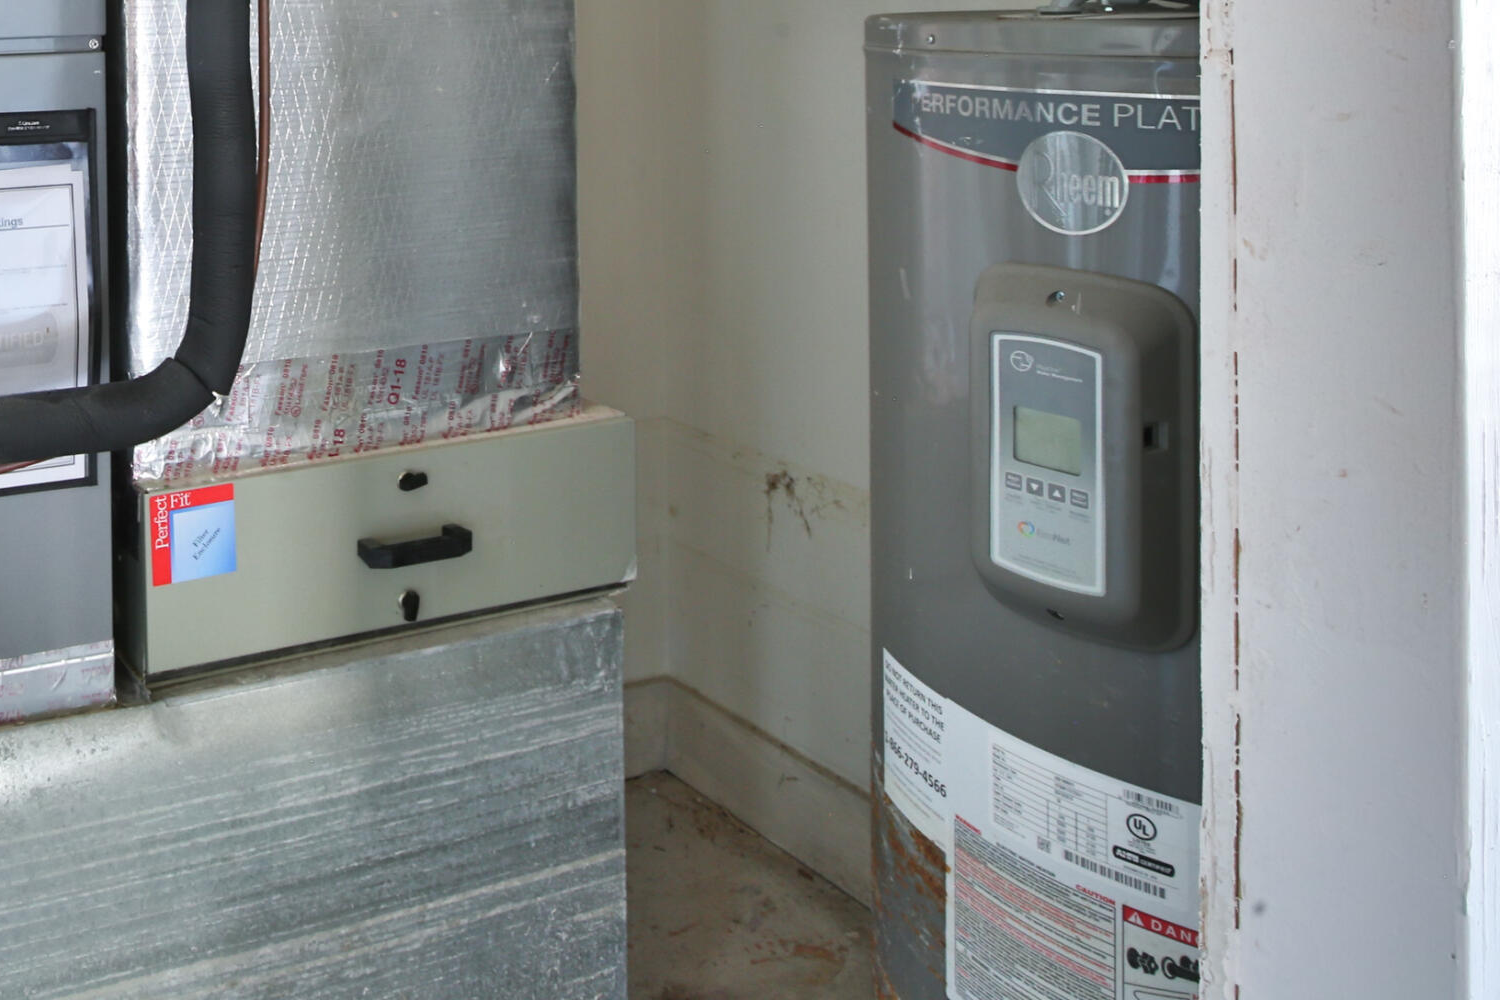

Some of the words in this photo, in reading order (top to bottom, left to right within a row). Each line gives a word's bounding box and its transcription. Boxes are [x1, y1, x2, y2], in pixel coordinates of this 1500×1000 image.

[387, 359, 407, 404] Q1-18
[154, 496, 169, 550] Perfect
[900, 690, 920, 711] HEATER
[921, 708, 929, 720] TO
[932, 716, 944, 731] THE
[903, 679, 926, 702] RETURN
[928, 698, 943, 715] THIS
[908, 713, 941, 743] PURCHASE
[1134, 818, 1149, 837] UL
[1076, 884, 1116, 905] CAUTION
[1151, 919, 1199, 944] DAN
